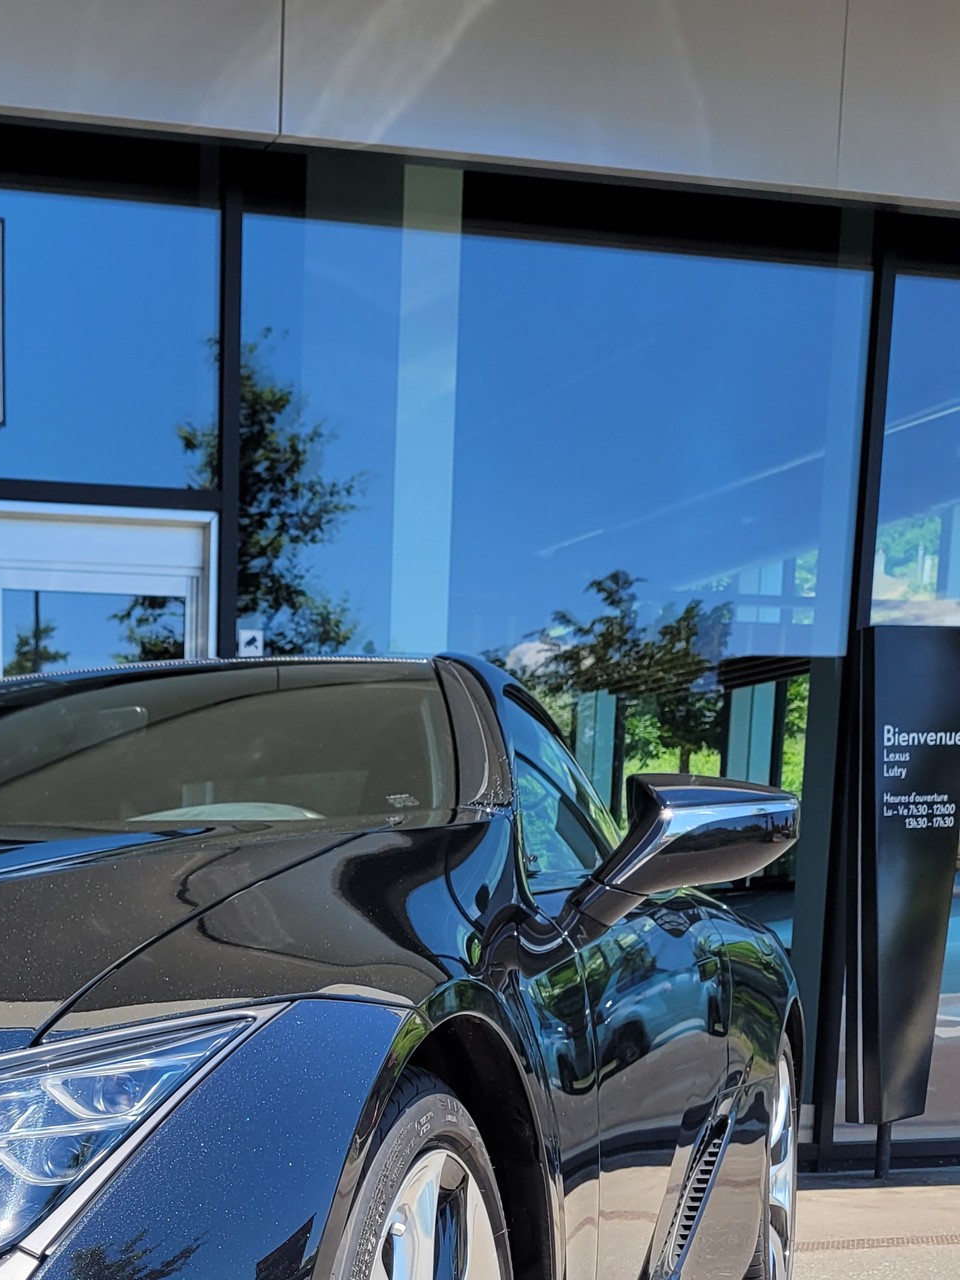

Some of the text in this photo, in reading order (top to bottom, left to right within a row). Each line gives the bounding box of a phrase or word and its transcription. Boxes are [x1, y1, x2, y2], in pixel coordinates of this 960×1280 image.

[883, 748, 910, 762] Lexus
[883, 763, 907, 779] Lutry
[883, 791, 909, 803] Heures
